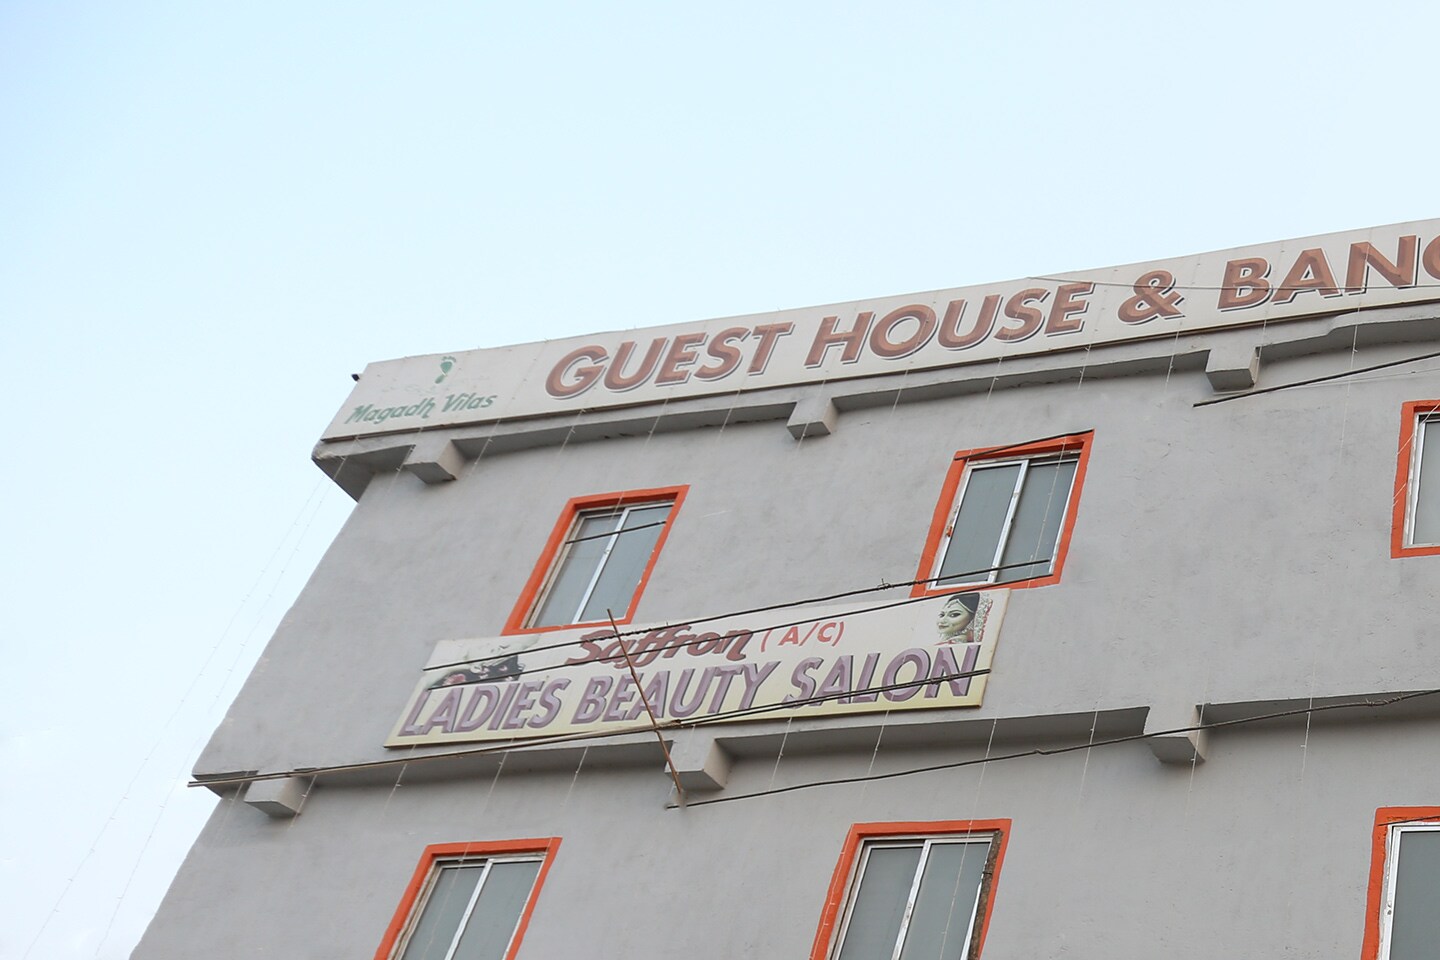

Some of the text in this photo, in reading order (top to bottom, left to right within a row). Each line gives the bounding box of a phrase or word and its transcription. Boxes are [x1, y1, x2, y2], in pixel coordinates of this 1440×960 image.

[545, 321, 794, 400] GUEST
[804, 281, 1094, 369] HOUSE
[1117, 270, 1184, 325] &
[344, 392, 498, 425] Magadh Vilas
[564, 624, 753, 669] Saffron
[398, 645, 982, 737] LADIES BEAUTY SALON
